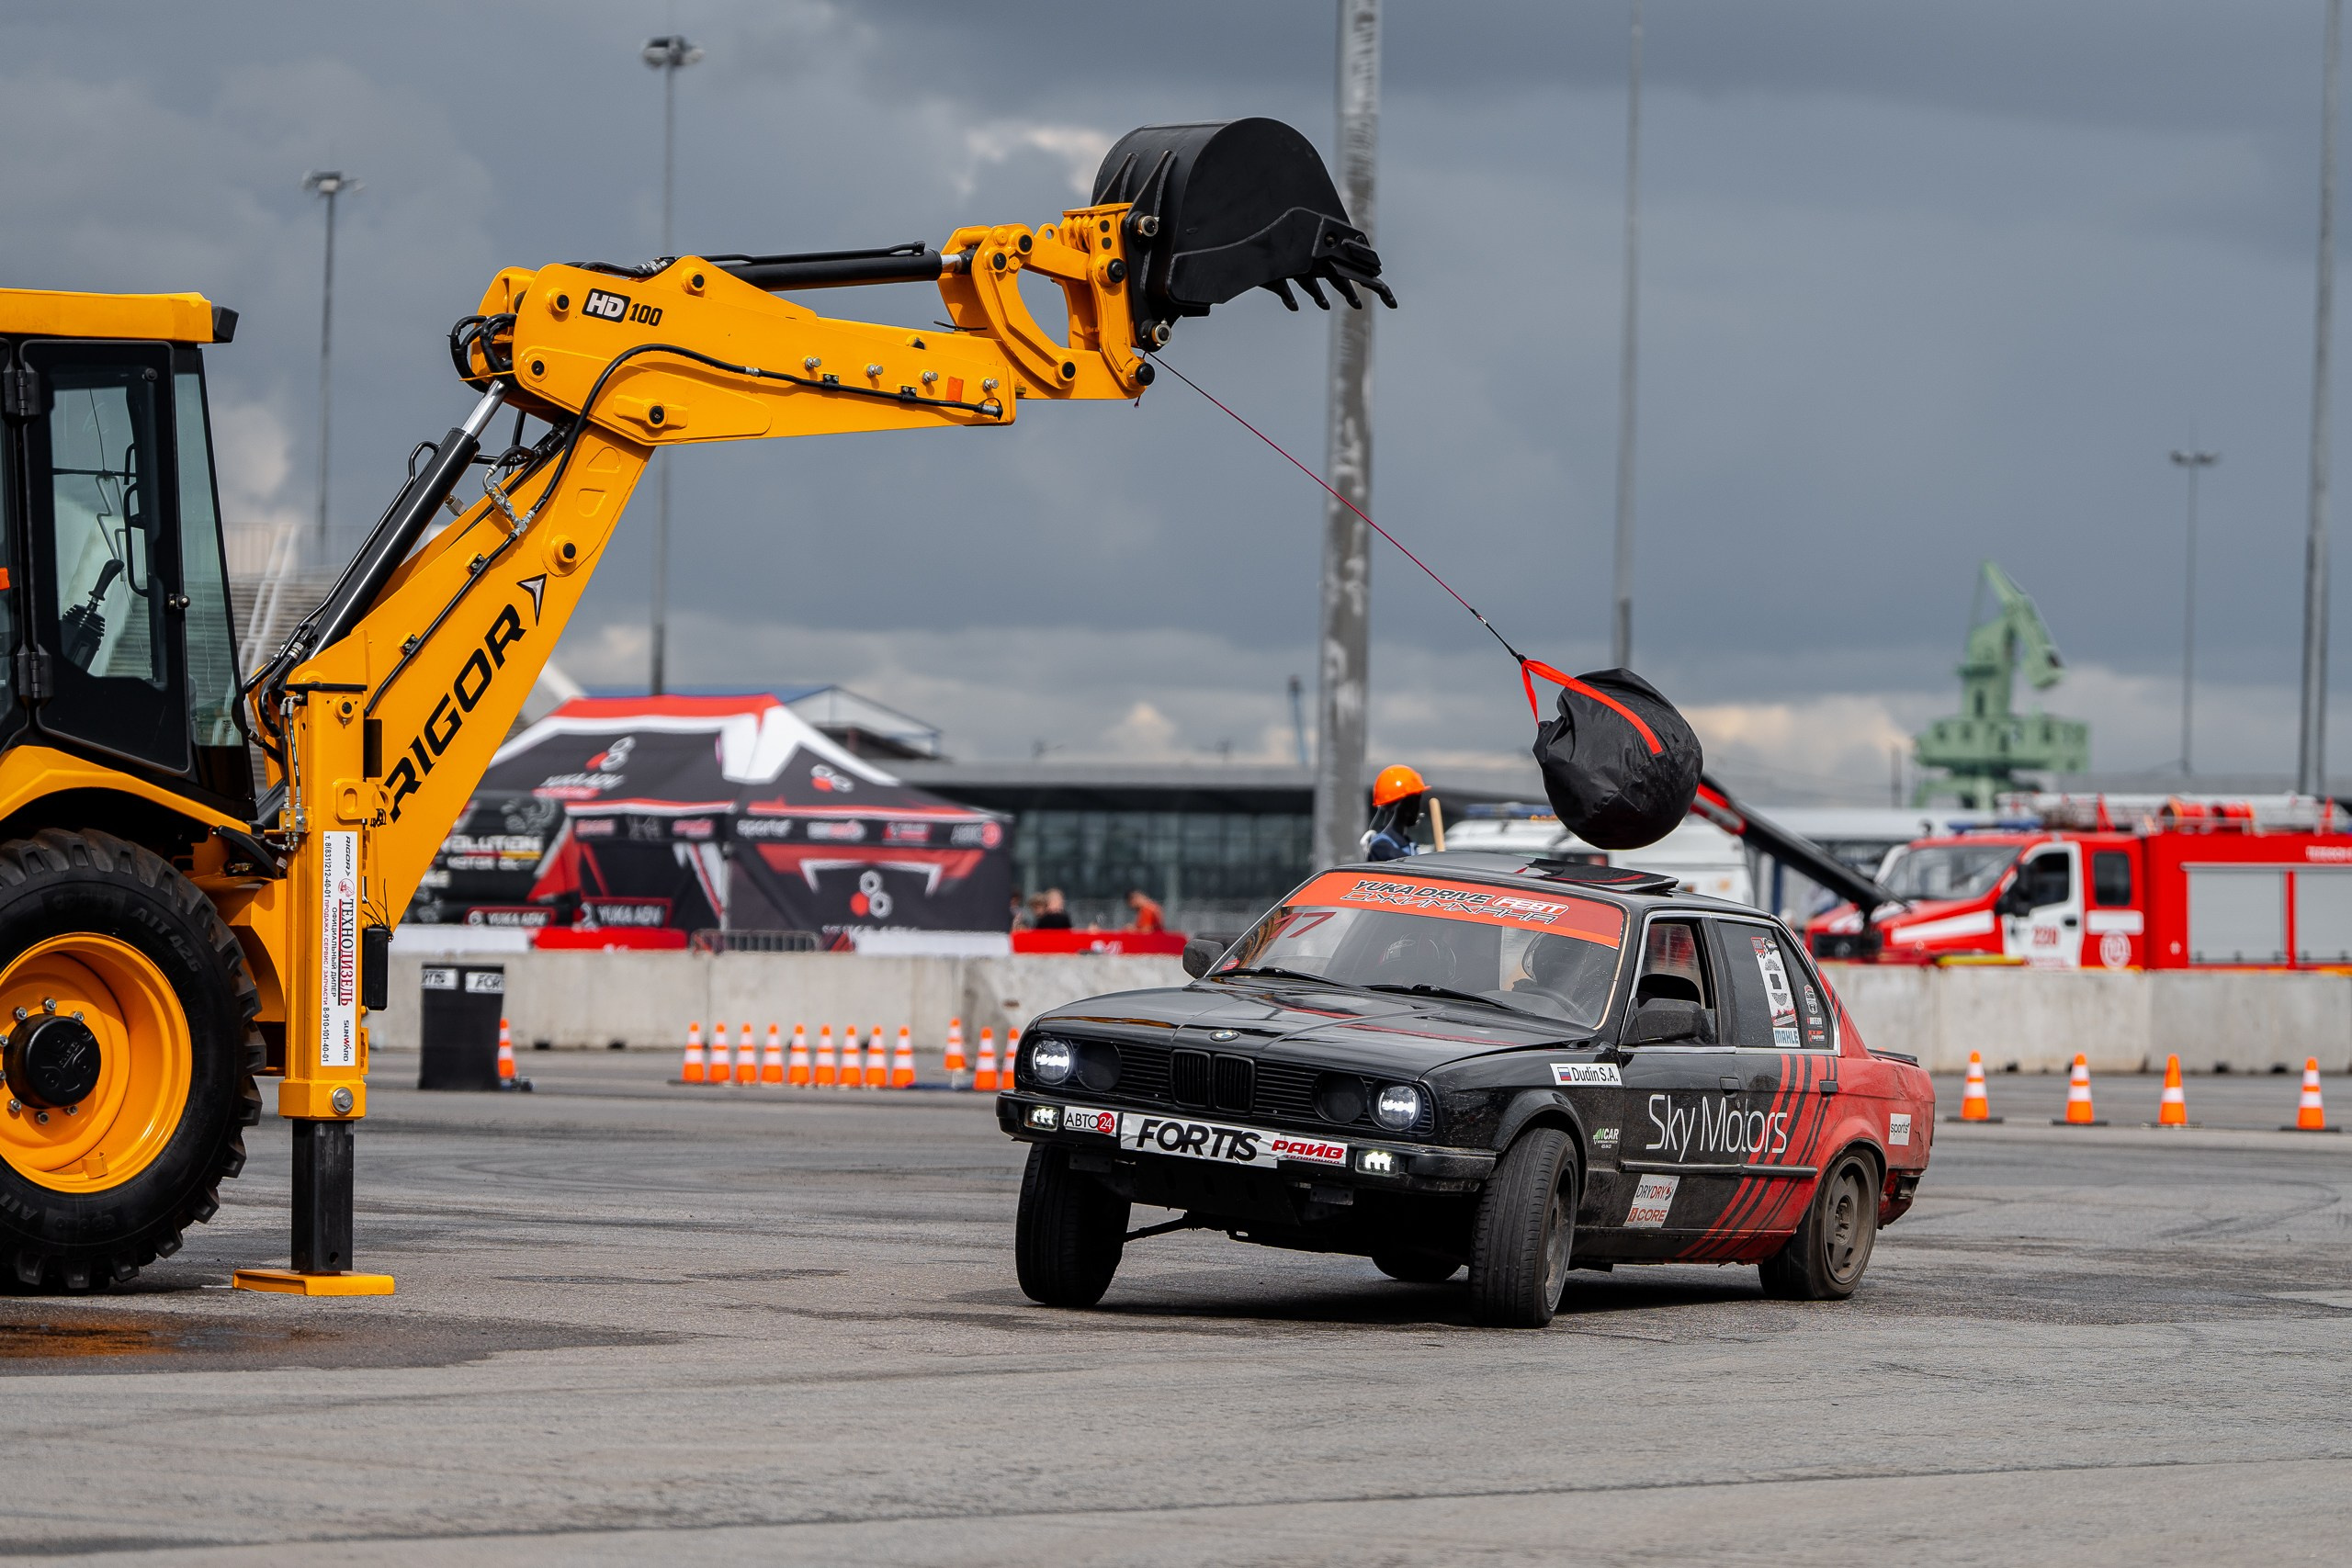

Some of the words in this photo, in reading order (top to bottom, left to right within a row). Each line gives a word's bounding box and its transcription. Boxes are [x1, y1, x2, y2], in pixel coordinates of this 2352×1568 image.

[586, 292, 626, 318] HD
[628, 302, 663, 327] 100
[383, 604, 527, 823] RIGOR
[1352, 879, 1416, 896] YUKA
[1412, 886, 1495, 905] DRIVE
[1496, 897, 1567, 913] FEST
[340, 898, 354, 1007] ТЕХНОДИЗЕЛЬ
[1774, 1030, 1799, 1044] MAHLE
[1571, 1066, 1600, 1081] Dudin
[1600, 1066, 1619, 1082] S.A.
[1136, 1118, 1262, 1162] FORTIS
[1645, 1095, 1696, 1163] Sky
[1700, 1096, 1788, 1154] Motors
[1635, 1185, 1667, 1200] DRYDRY
